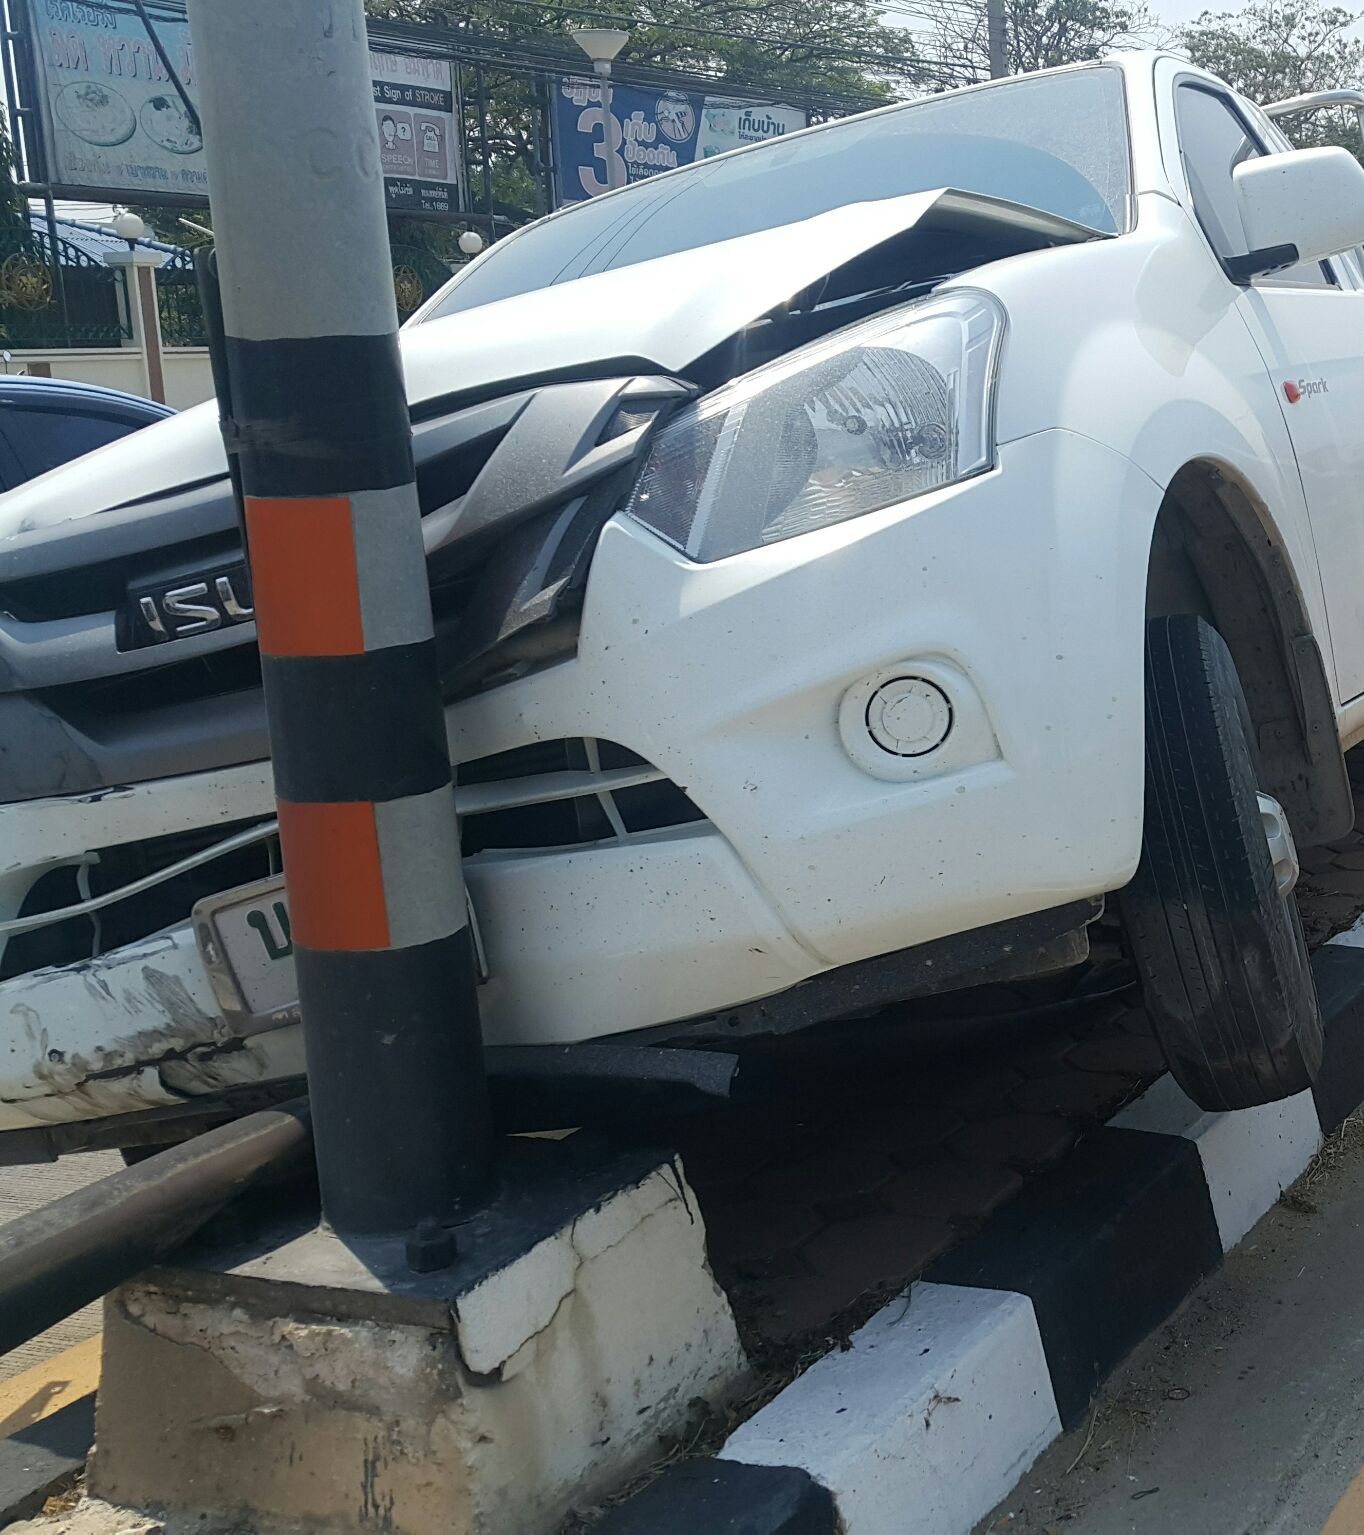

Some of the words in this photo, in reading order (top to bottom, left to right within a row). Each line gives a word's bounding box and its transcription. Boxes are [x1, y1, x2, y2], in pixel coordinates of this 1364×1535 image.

[384, 85, 401, 101] Sign
[404, 89, 413, 101] of
[415, 90, 445, 105] STROKE
[623, 111, 657, 143] เก็บ
[738, 110, 785, 136] เก็บบ้าน
[425, 157, 439, 168] TIME
[577, 107, 628, 199] 3
[624, 139, 678, 168] ป้องกัน
[1298, 378, 1329, 399] Spark
[139, 576, 254, 641] ISU
